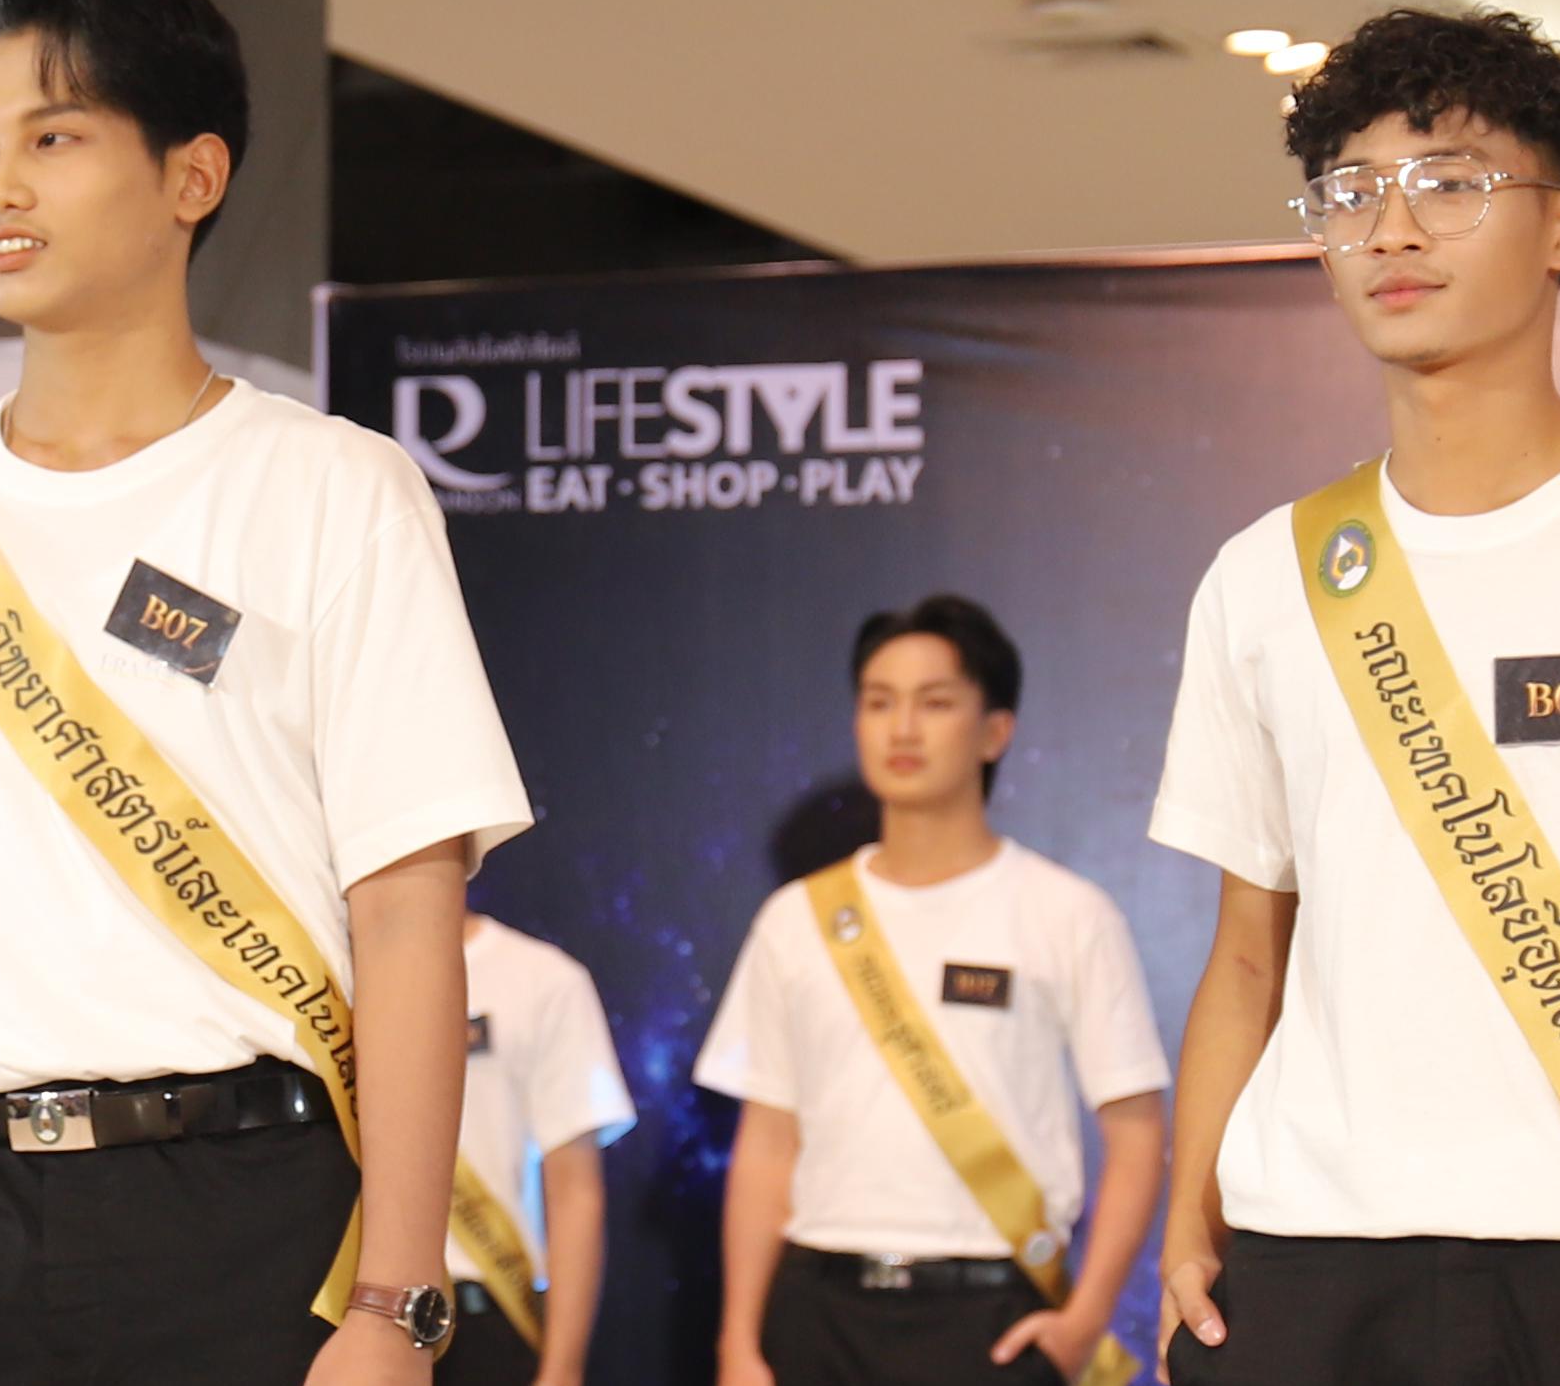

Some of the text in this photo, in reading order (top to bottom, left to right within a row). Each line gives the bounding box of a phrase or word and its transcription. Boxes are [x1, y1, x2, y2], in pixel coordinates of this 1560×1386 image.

[525, 358, 925, 463] LIFESTYLE
[525, 464, 614, 513] EAT
[639, 459, 780, 509] SHOP
[800, 455, 925, 506] PLAY
[139, 593, 208, 650] B07
